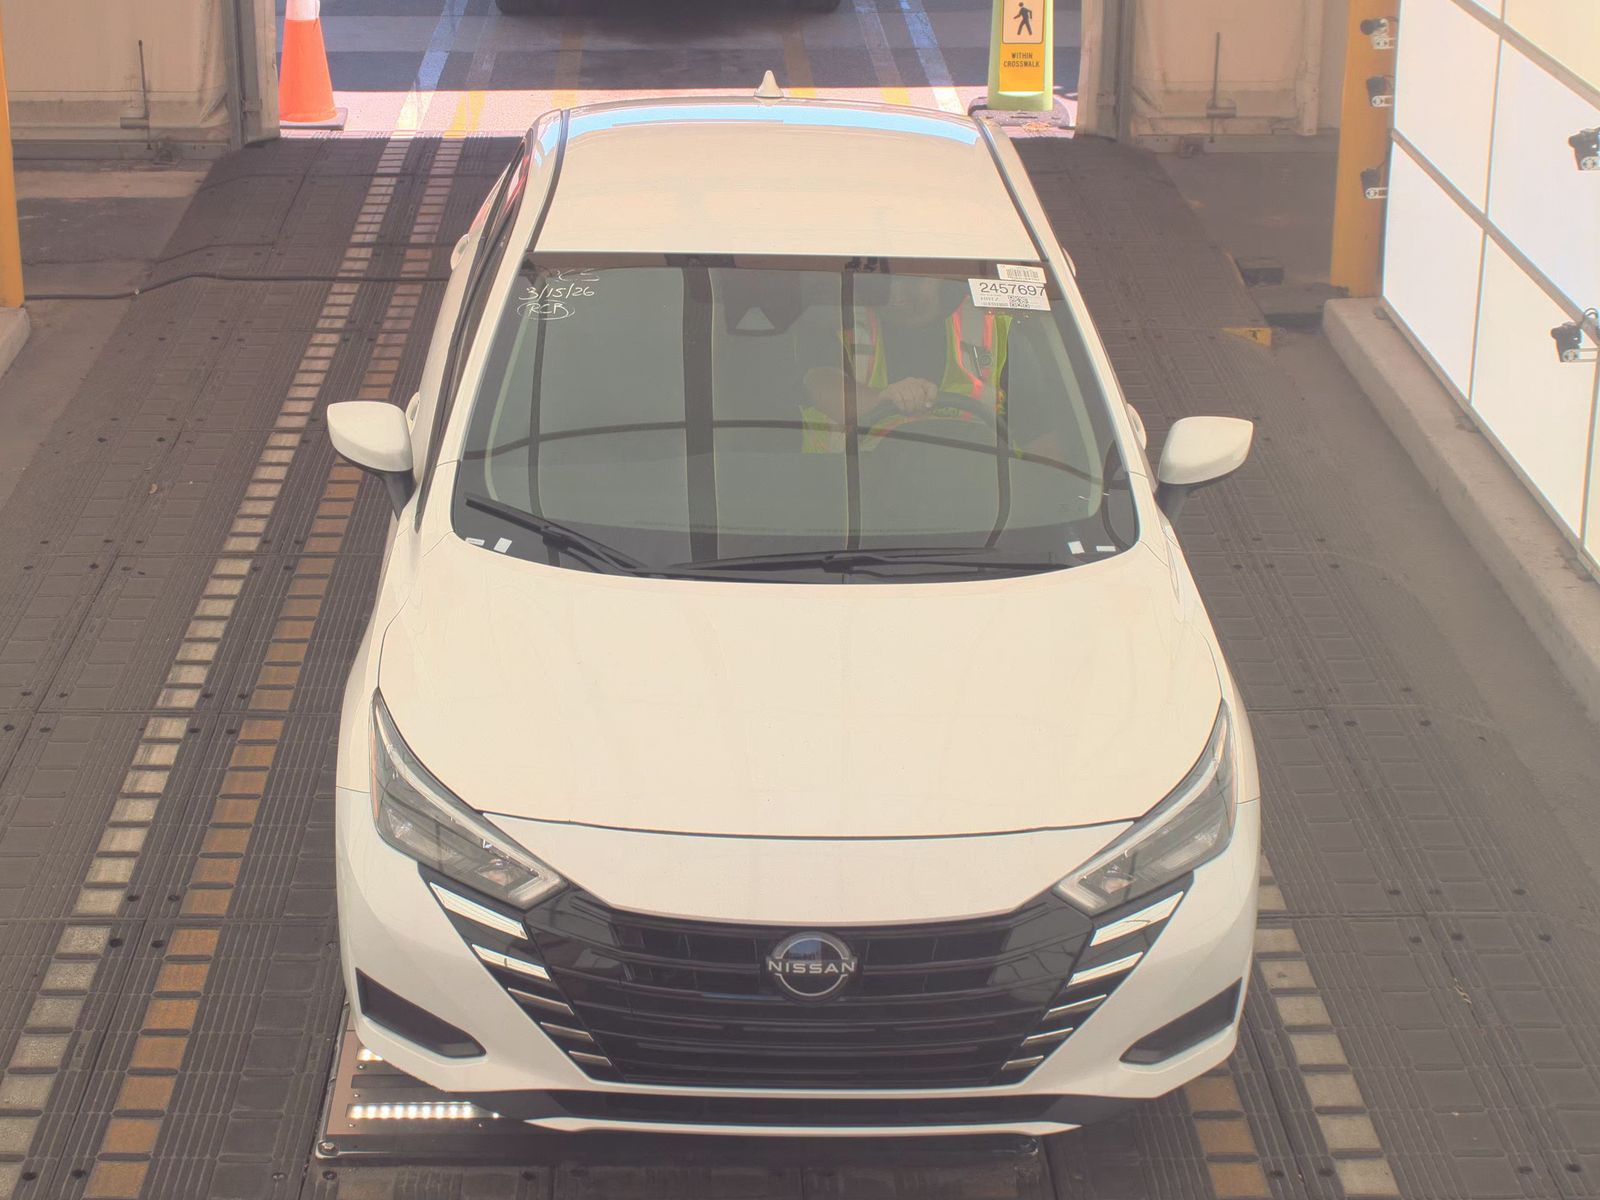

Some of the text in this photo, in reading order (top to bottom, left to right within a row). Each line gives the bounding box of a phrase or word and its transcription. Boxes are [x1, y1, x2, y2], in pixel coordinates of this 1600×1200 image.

[1003, 60, 1040, 68] CROSSWALK
[519, 283, 595, 300] 3/15/26
[979, 282, 1046, 297] 2457697
[768, 960, 855, 974] NISSAN
